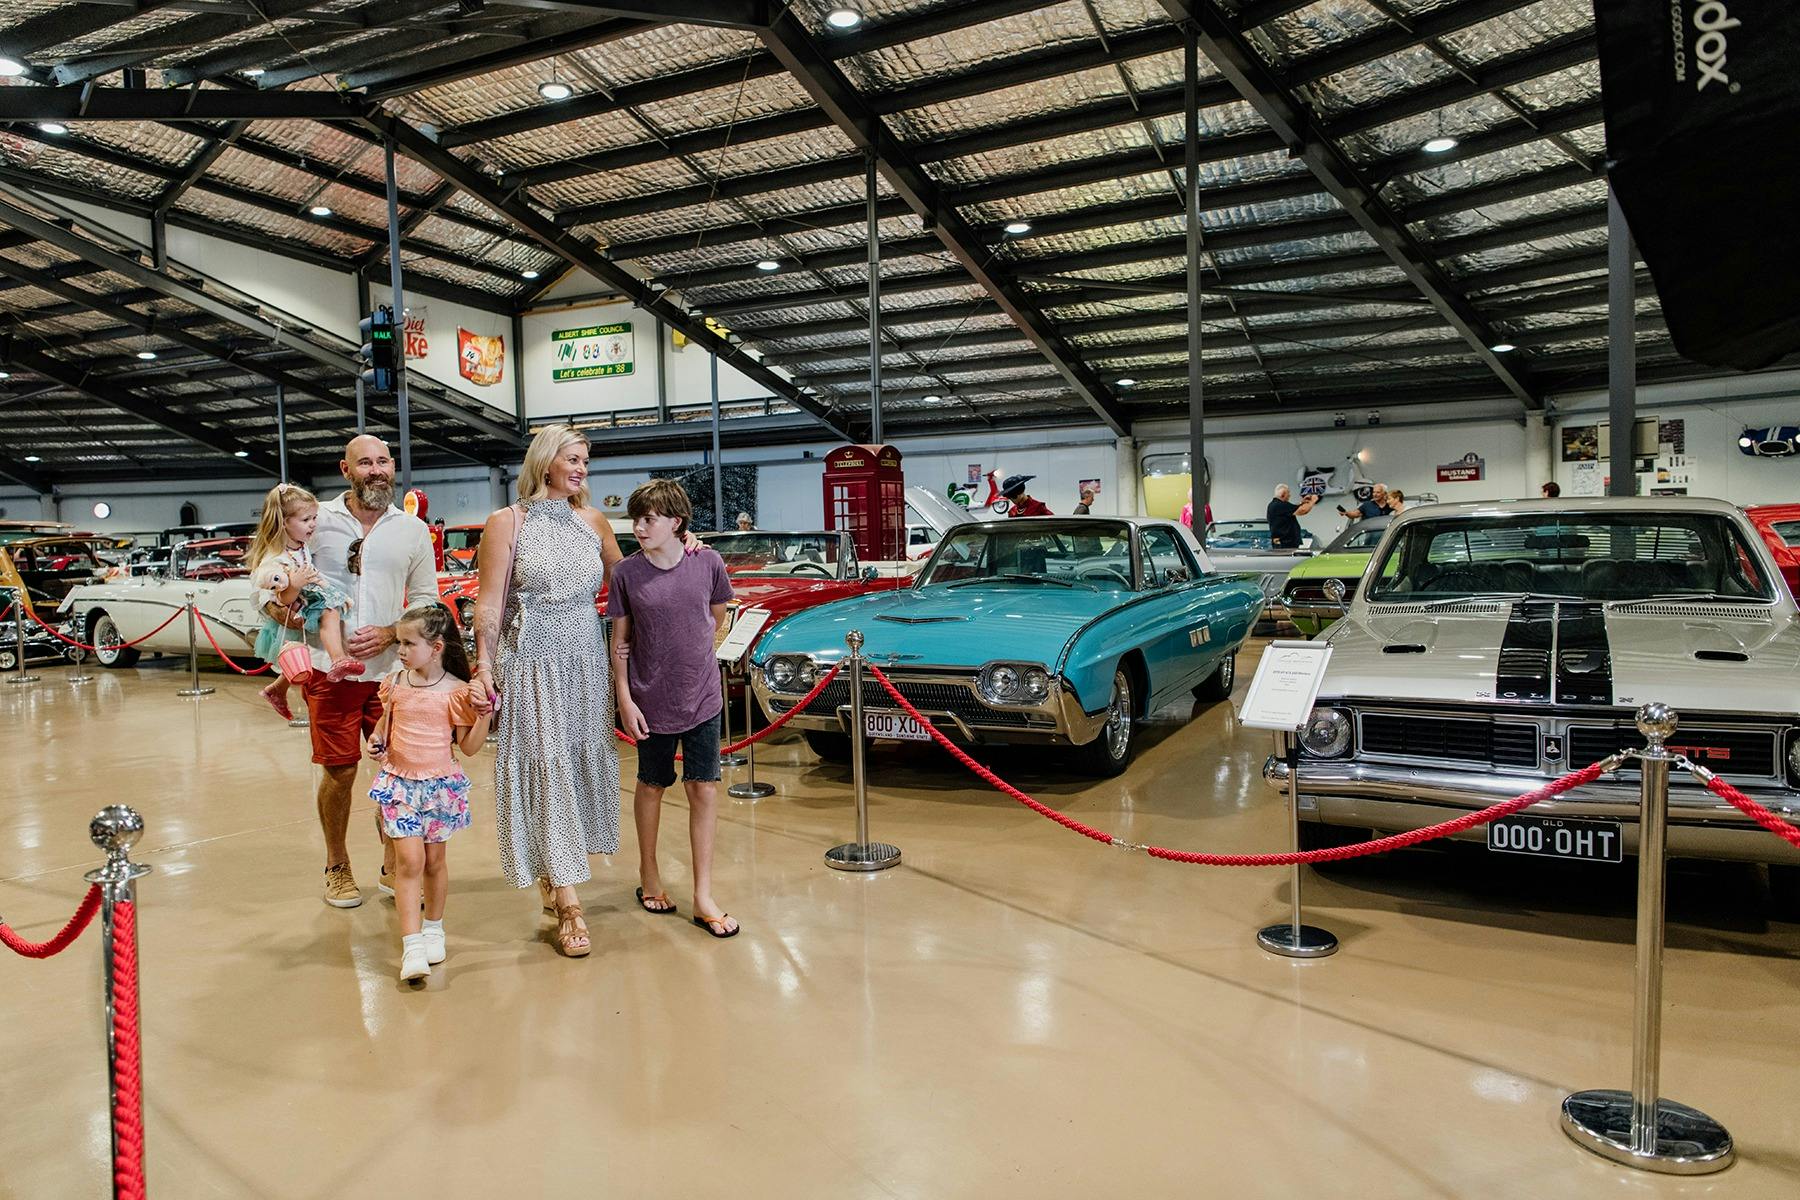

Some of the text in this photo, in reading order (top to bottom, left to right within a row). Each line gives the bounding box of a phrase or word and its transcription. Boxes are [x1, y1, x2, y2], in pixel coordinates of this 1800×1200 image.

[1693, 0, 1742, 92] dox
[558, 325, 625, 339] ALBERT SHIRE COUNCIL
[560, 369, 575, 379] Let's
[577, 367, 605, 377] celebrate
[607, 365, 613, 374] in
[1542, 819, 1564, 827] QLD
